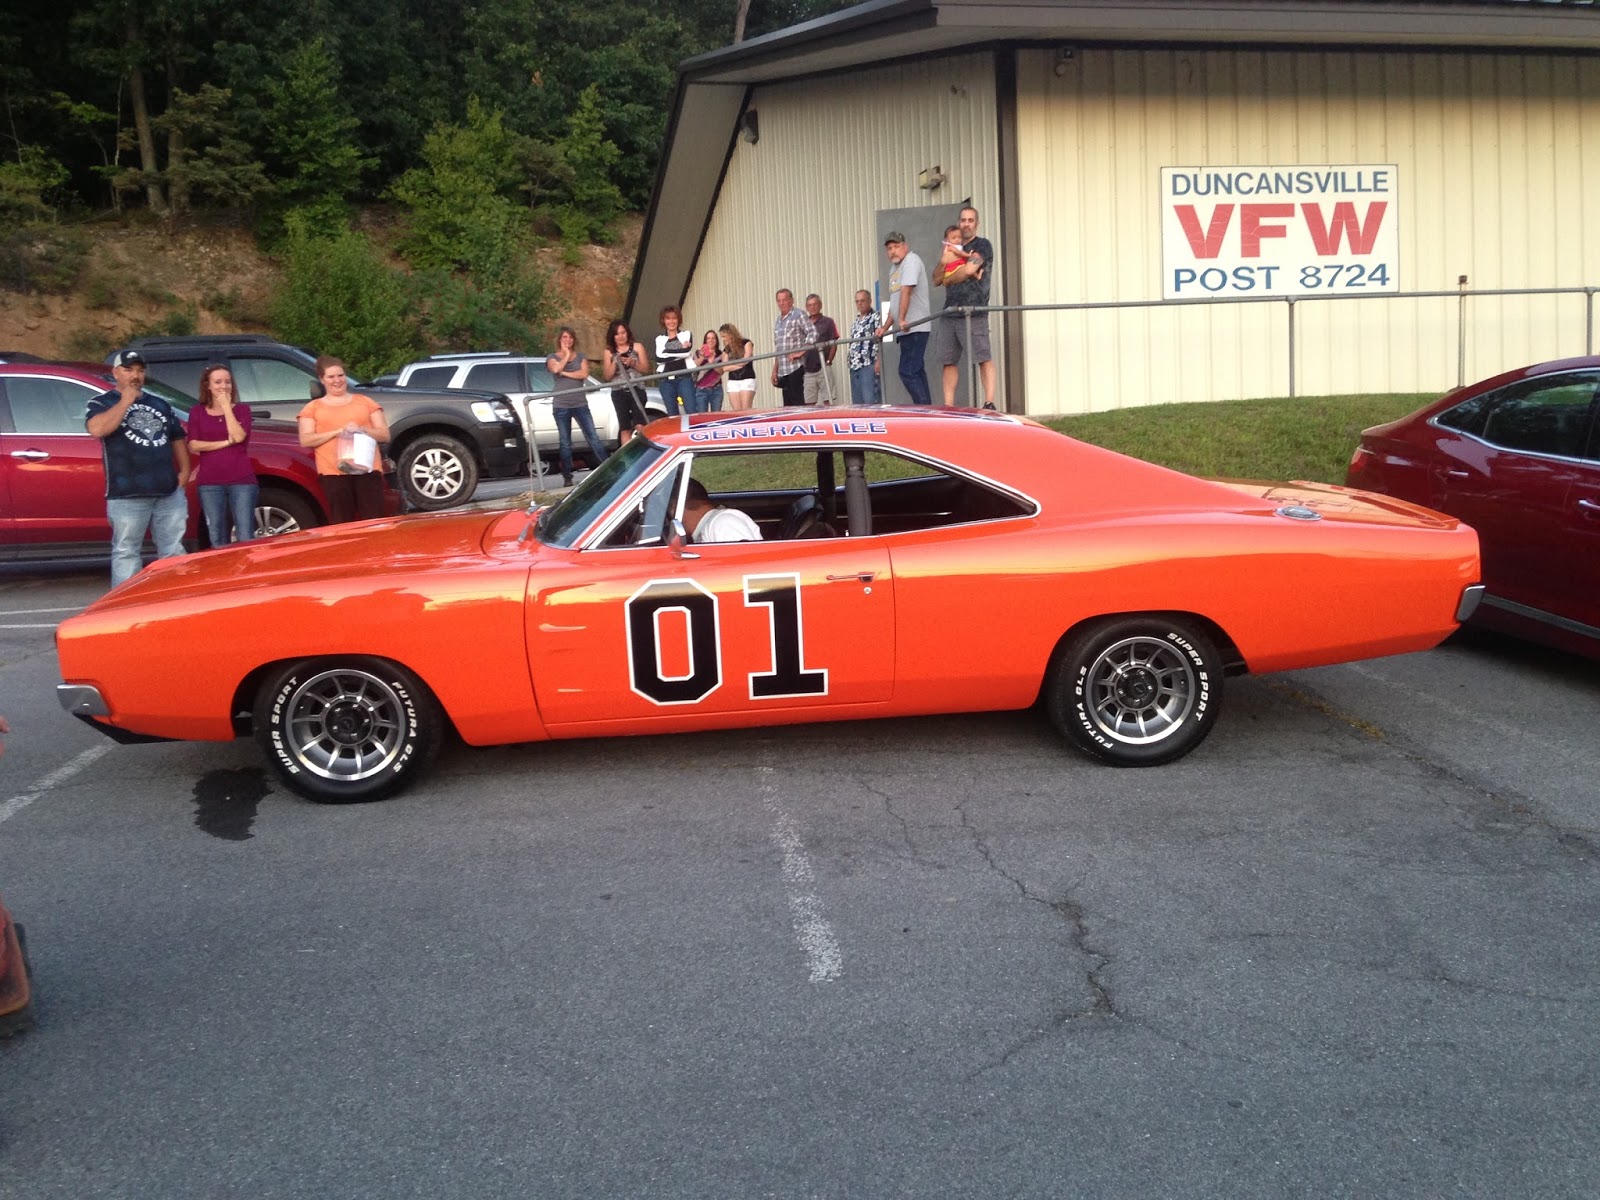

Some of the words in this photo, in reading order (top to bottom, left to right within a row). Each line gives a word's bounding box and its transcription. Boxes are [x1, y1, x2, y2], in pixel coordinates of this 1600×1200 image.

[1171, 171, 1389, 196] DUNCANSVILLE
[1173, 201, 1388, 259] VFW
[1174, 266, 1280, 292] POST
[1299, 263, 1390, 289] 8724
[125, 430, 150, 447] LIVE
[688, 421, 826, 441] GENERAL
[833, 420, 887, 434] LEE
[624, 572, 828, 706] 01
[1075, 665, 1088, 696] GLS
[1166, 632, 1204, 667] SUPER
[1195, 671, 1209, 722] SPORT
[271, 676, 298, 724] SPORT
[391, 681, 418, 738] FUTURA
[1076, 703, 1114, 749] FUTURA
[271, 730, 300, 775] SUPER
[392, 743, 413, 773] GLS
